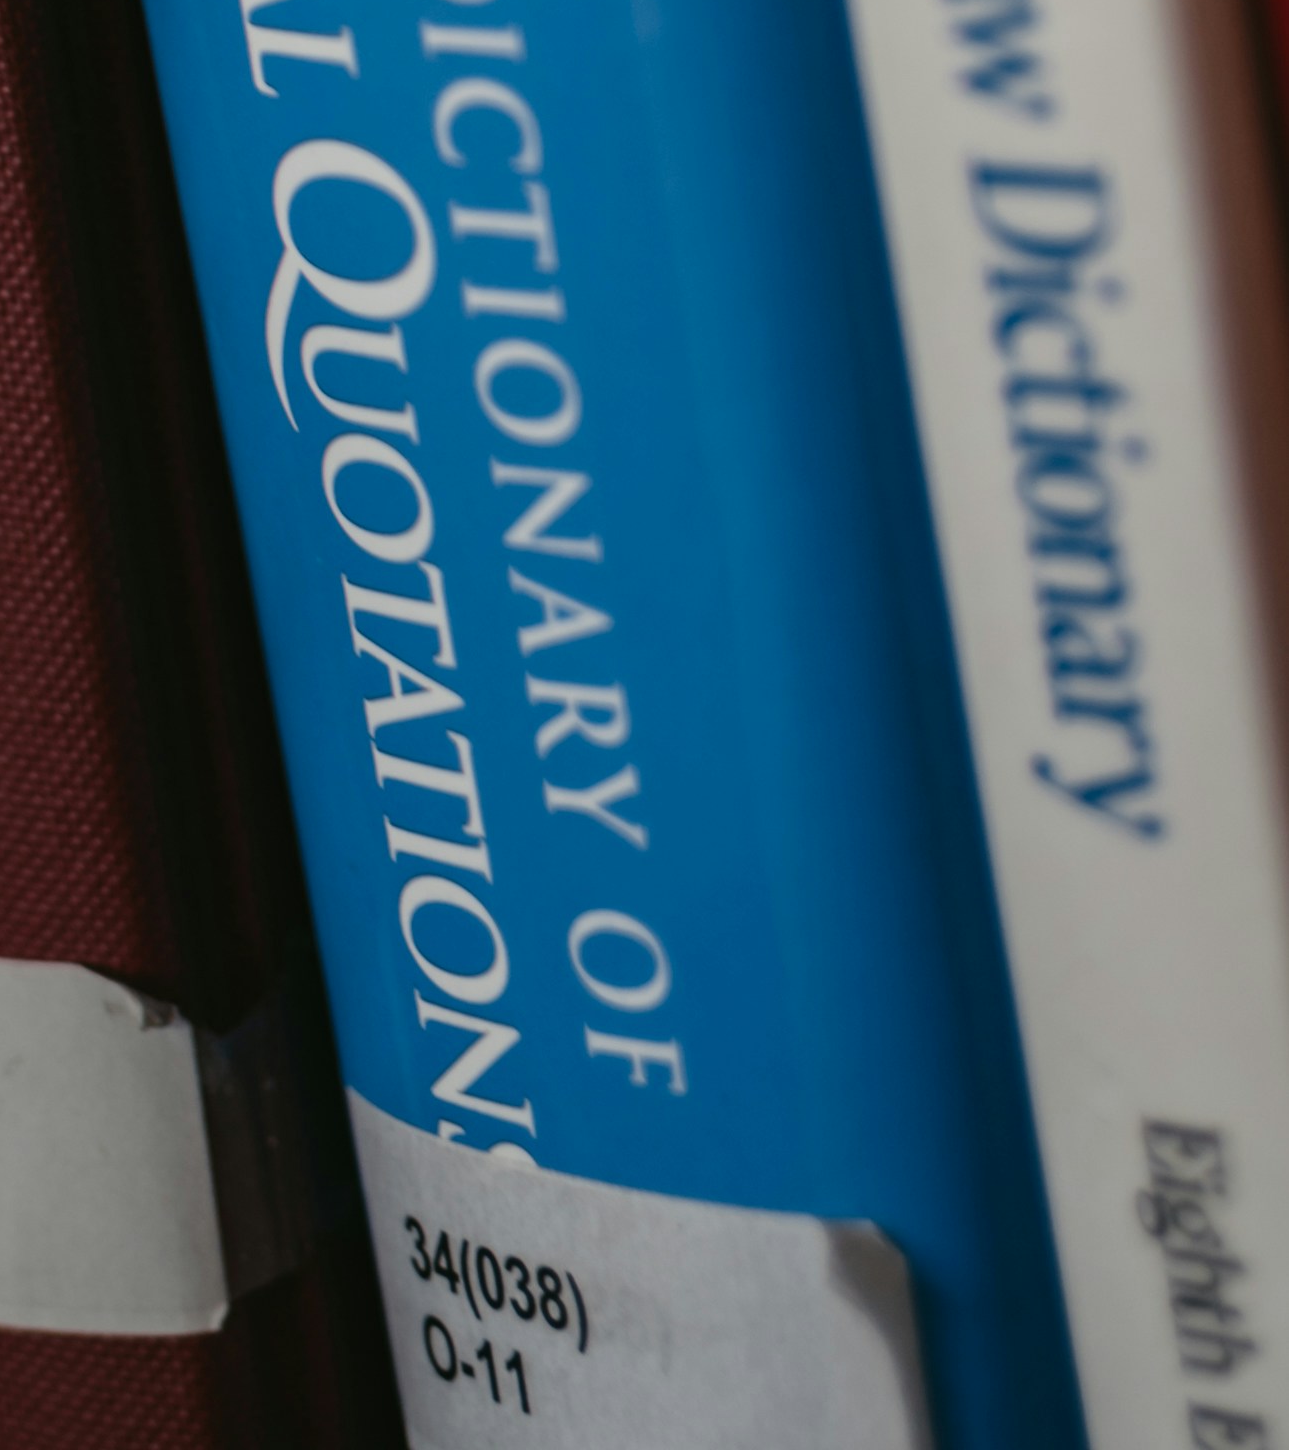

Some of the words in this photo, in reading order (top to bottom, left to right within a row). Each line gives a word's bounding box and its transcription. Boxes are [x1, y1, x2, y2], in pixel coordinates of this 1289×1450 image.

[964, 157, 1168, 843] Dictionary
[264, 136, 539, 1168] QUOTATION
[568, 909, 688, 1100] OF
[404, 1214, 589, 1354] 34(038)
[1135, 1114, 1256, 1377] Eighth
